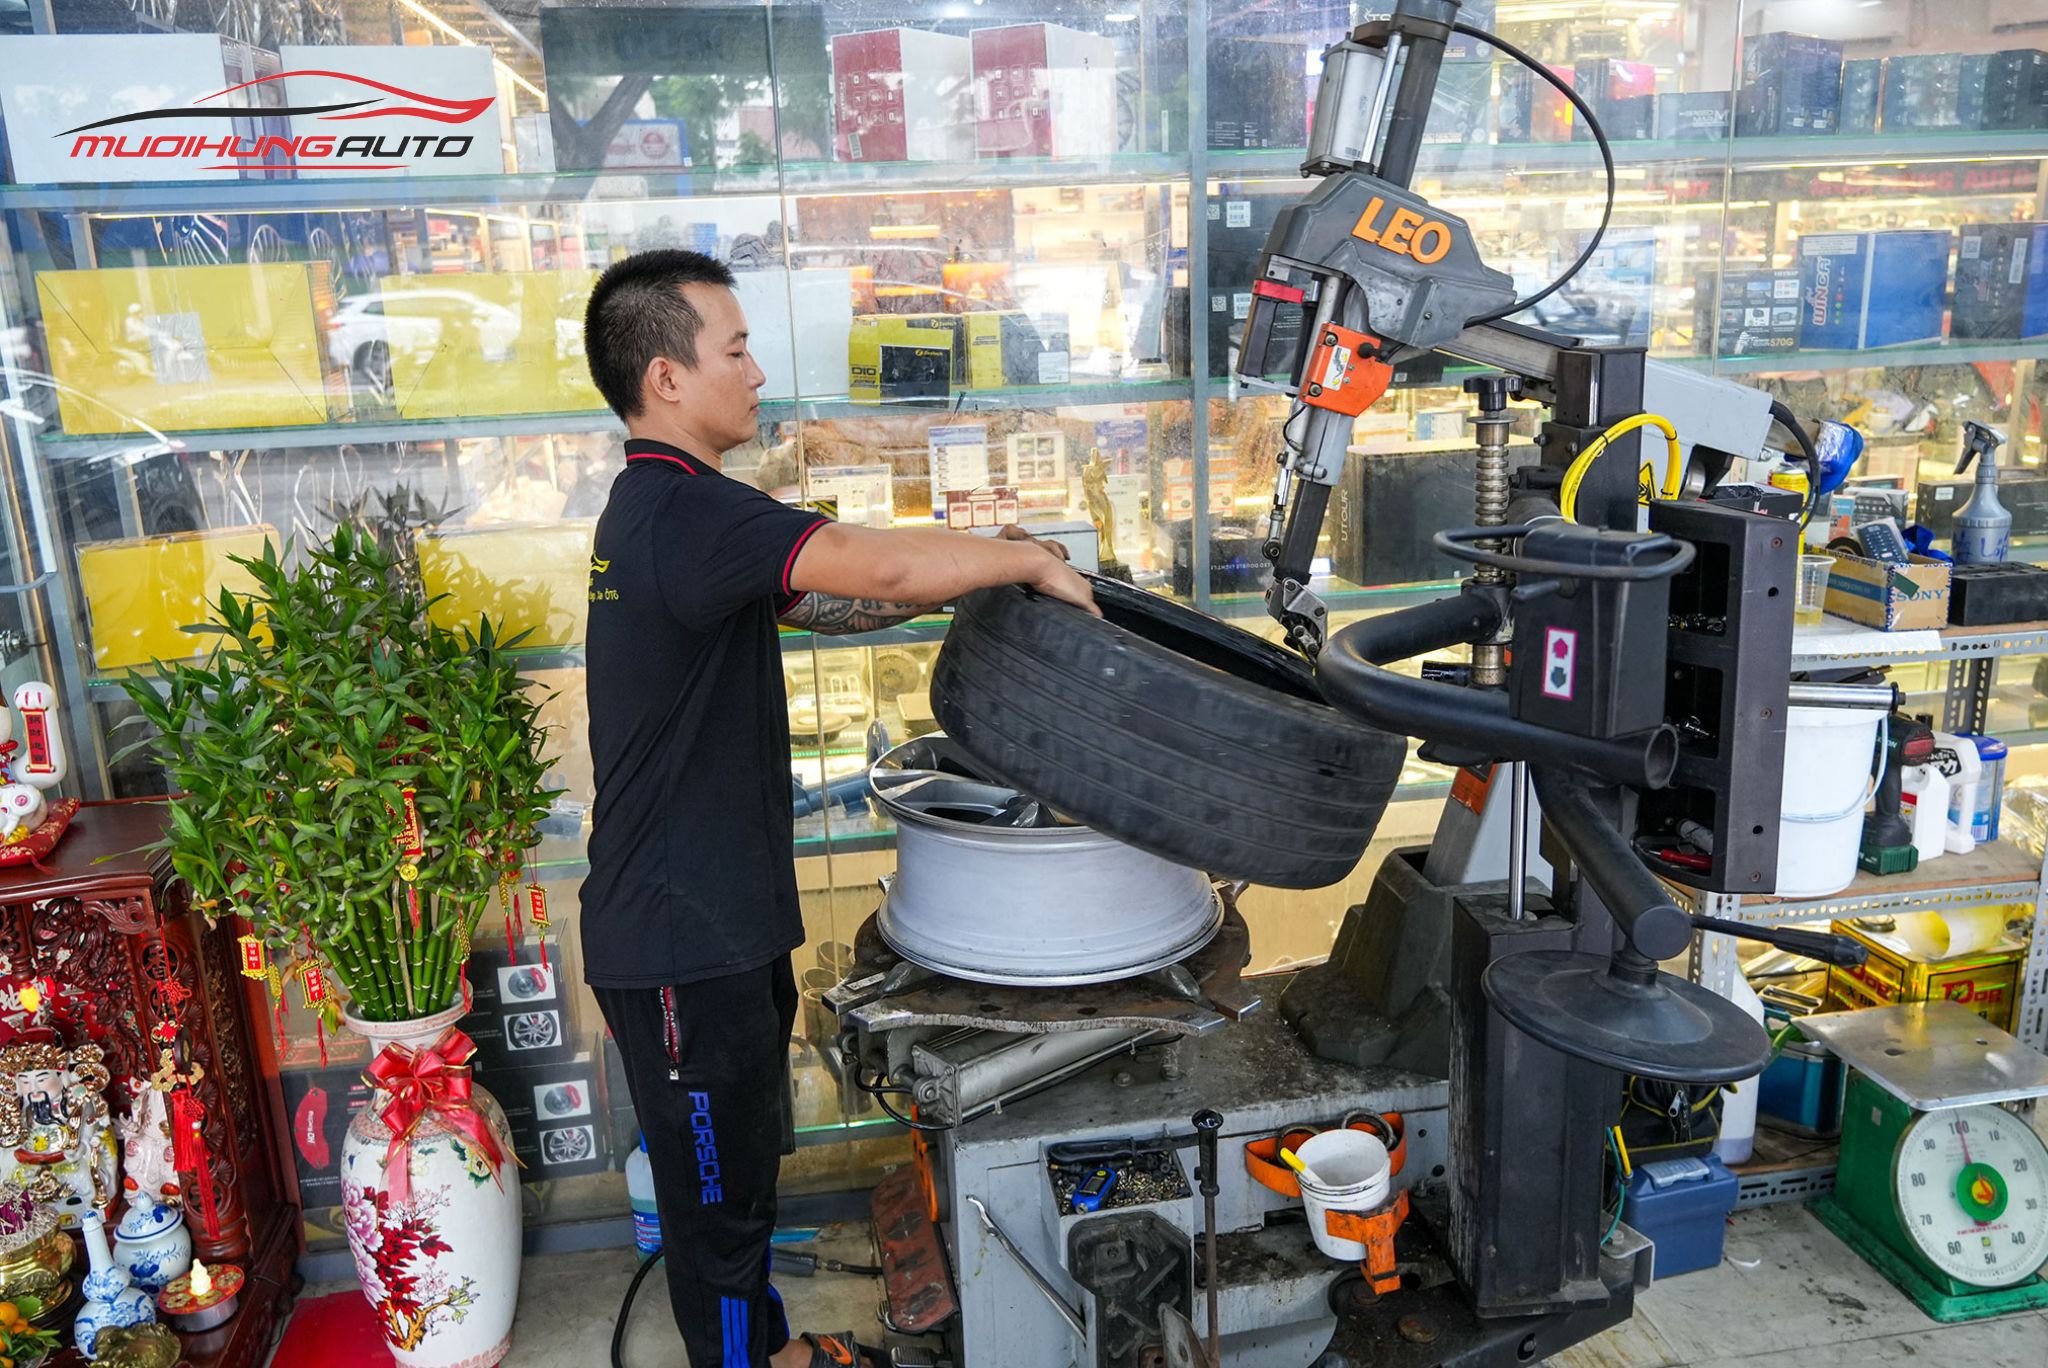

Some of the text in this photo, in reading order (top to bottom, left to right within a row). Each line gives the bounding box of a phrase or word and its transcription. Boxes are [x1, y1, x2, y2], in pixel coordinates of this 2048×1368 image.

[1351, 196, 1452, 265] LEO
[1896, 589, 1944, 601] SONY
[1988, 1130, 2000, 1142] 10
[688, 1092, 722, 1205] PORSCHE
[1923, 1138, 1937, 1150] 90
[2012, 1158, 2028, 1173] 20
[1911, 1173, 1926, 1187] 80
[2025, 1198, 2038, 1211] 30
[1919, 1213, 1933, 1226] 70
[2011, 1231, 2026, 1246] 40
[1947, 1240, 1962, 1256] 60
[1983, 1252, 1997, 1265] 50
